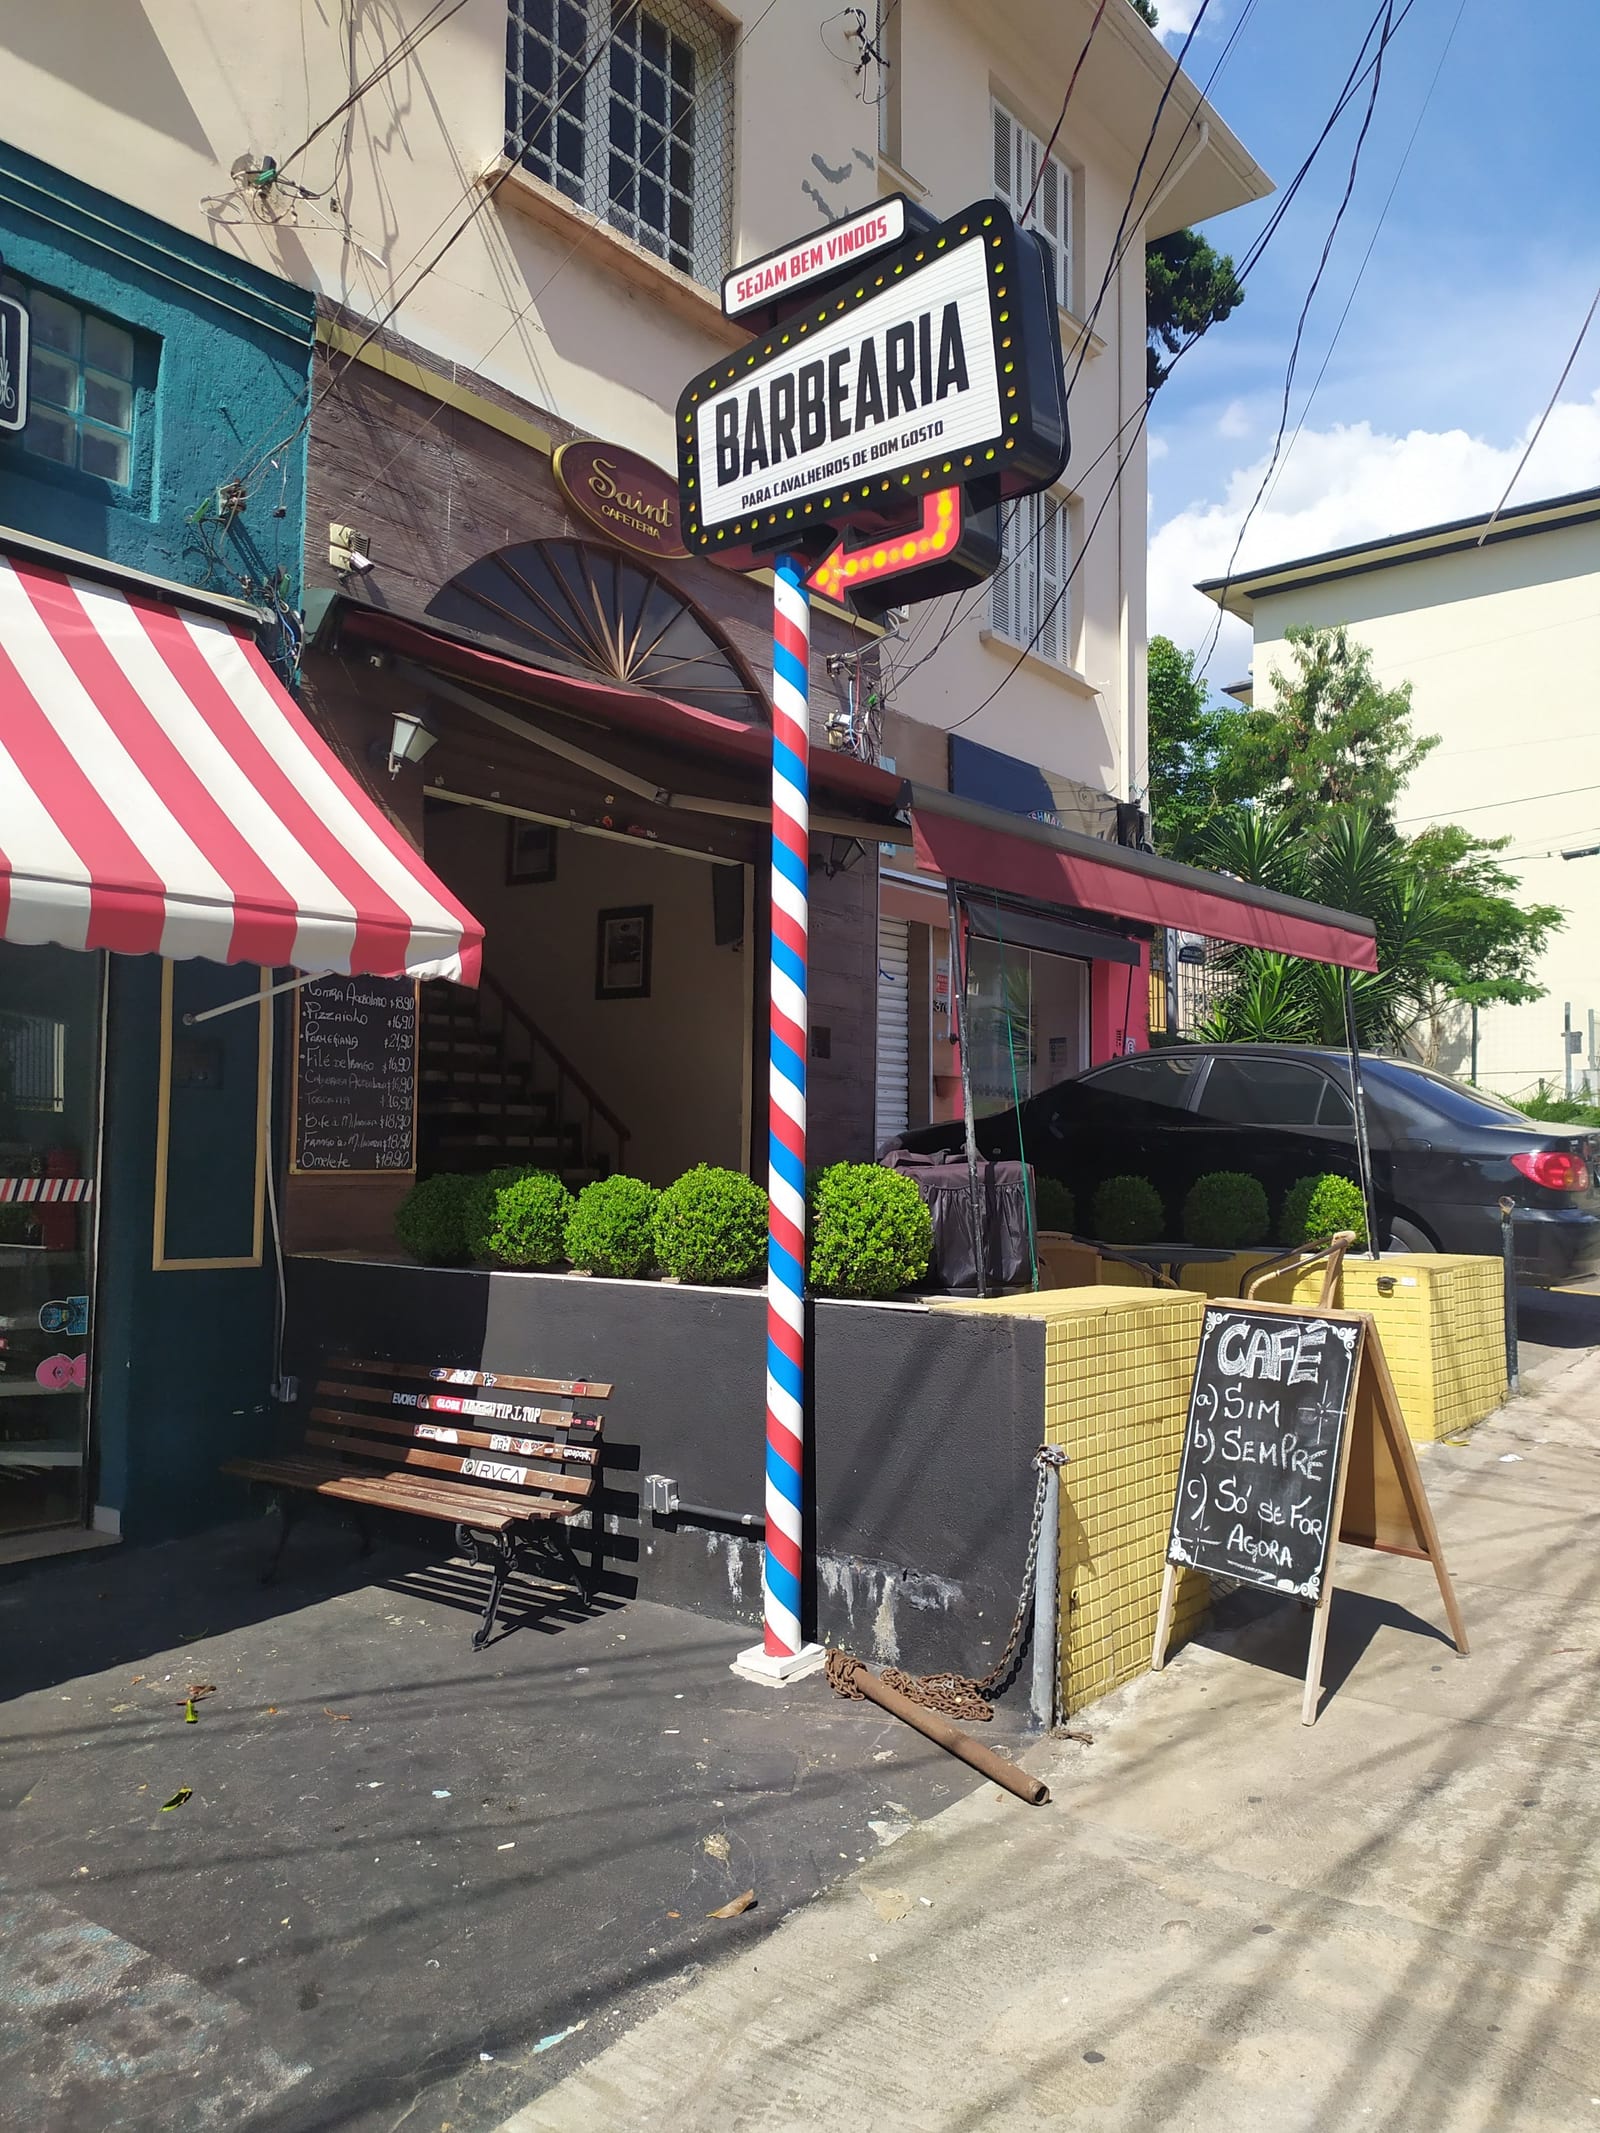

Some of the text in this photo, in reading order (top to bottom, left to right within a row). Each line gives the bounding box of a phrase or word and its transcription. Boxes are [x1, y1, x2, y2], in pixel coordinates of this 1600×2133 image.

[737, 215, 888, 302] SEJAM BEM VINDOS
[715, 301, 969, 487] BARBEARIA
[588, 458, 675, 528] Saint
[741, 420, 944, 510] PARA CAVALHEIROS DE BOM GOSTO
[601, 504, 660, 540] CAFETERIA
[1217, 1319, 1328, 1386] CAFÉ
[1196, 1383, 1219, 1422] a)
[1194, 1420, 1215, 1464] b)
[480, 1464, 520, 1483] RVCA
[1227, 1523, 1293, 1569] AGORA
